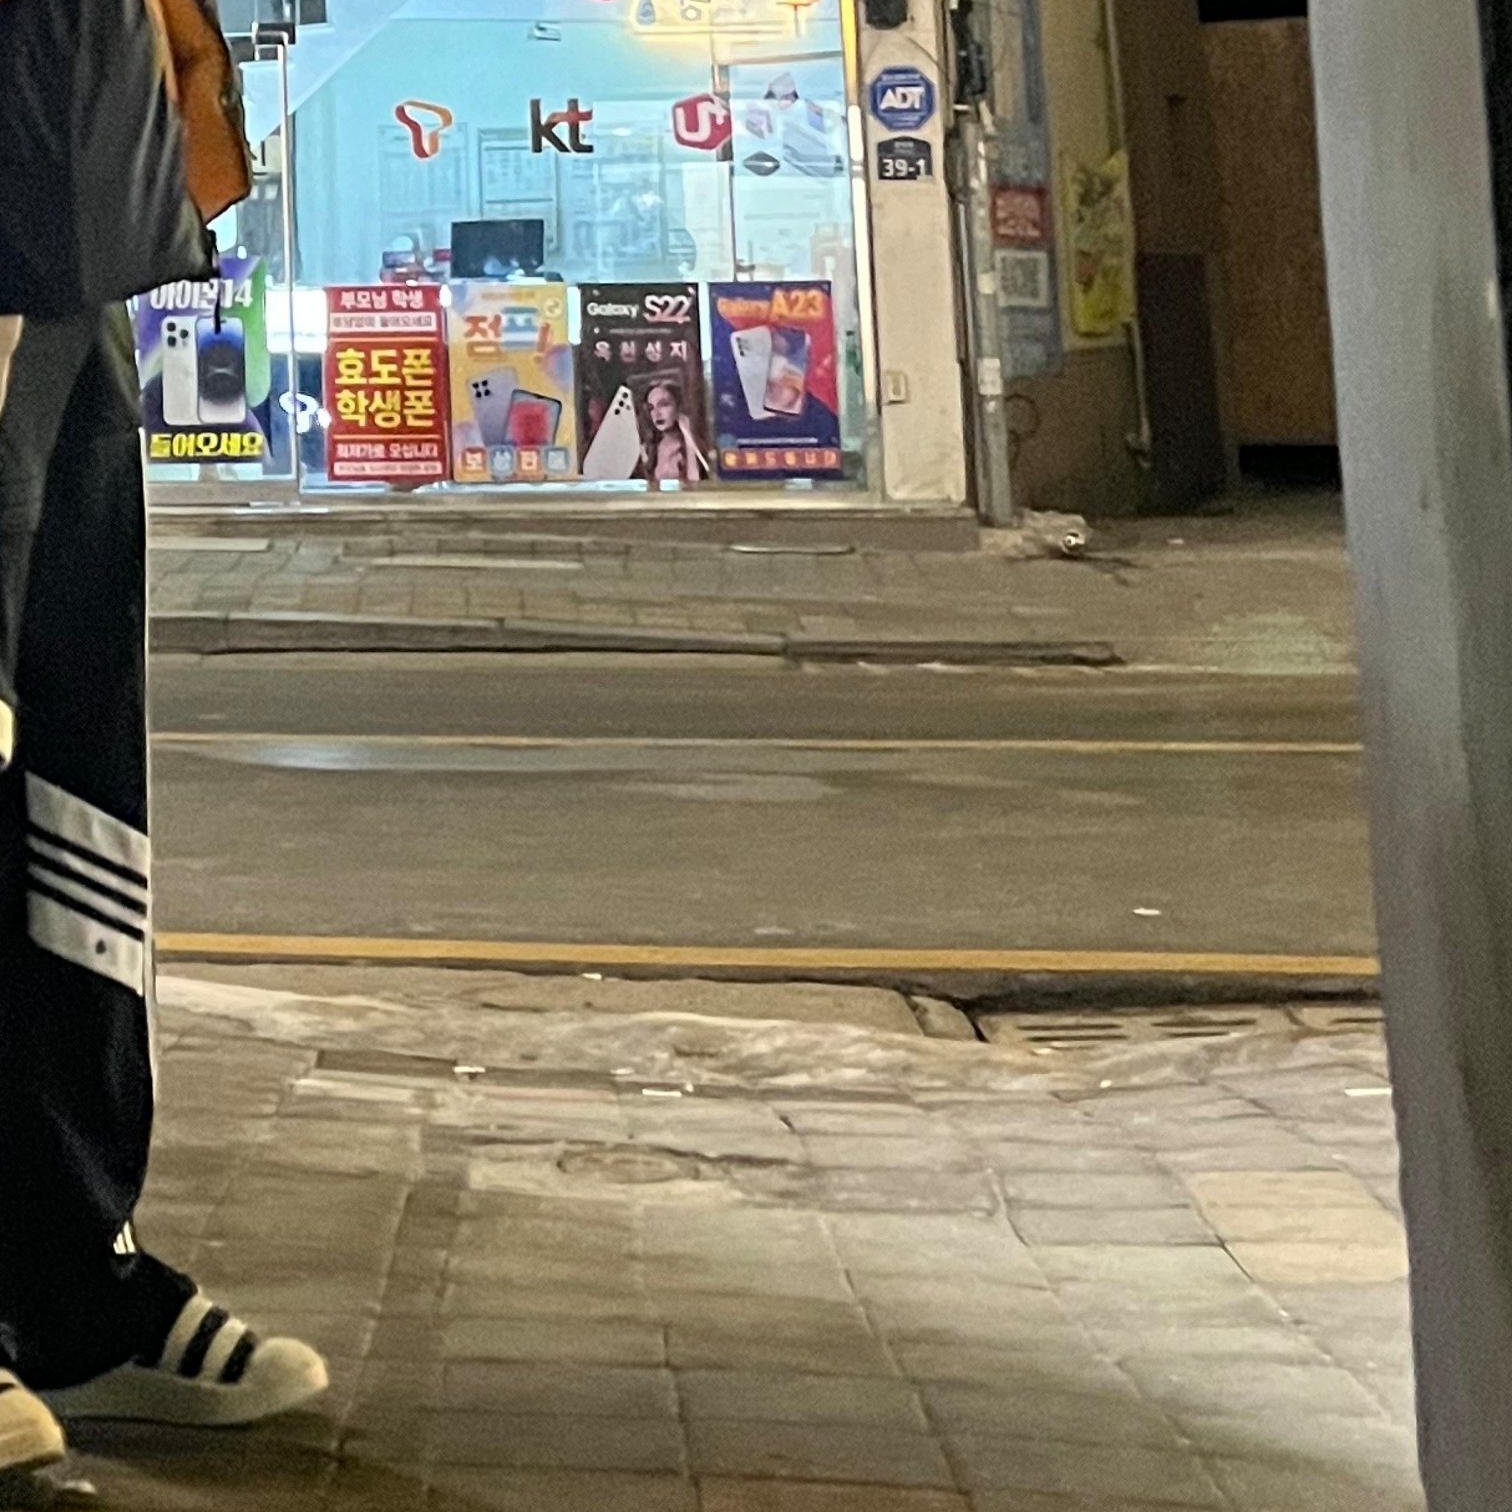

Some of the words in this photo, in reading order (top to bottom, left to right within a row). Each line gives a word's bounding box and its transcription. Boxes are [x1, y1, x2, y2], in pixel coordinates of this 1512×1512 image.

[879, 86, 925, 110] ADT
[530, 98, 593, 153] kt
[882, 158, 926, 178] 39-1
[340, 290, 387, 309] 부모님
[392, 289, 423, 309] 학생
[587, 302, 638, 318] Galaxy
[643, 294, 691, 323] S22
[772, 288, 825, 319] A23
[335, 348, 434, 386] 효도폰
[335, 390, 435, 428] 학생폰
[150, 432, 263, 458] 들어오세요
